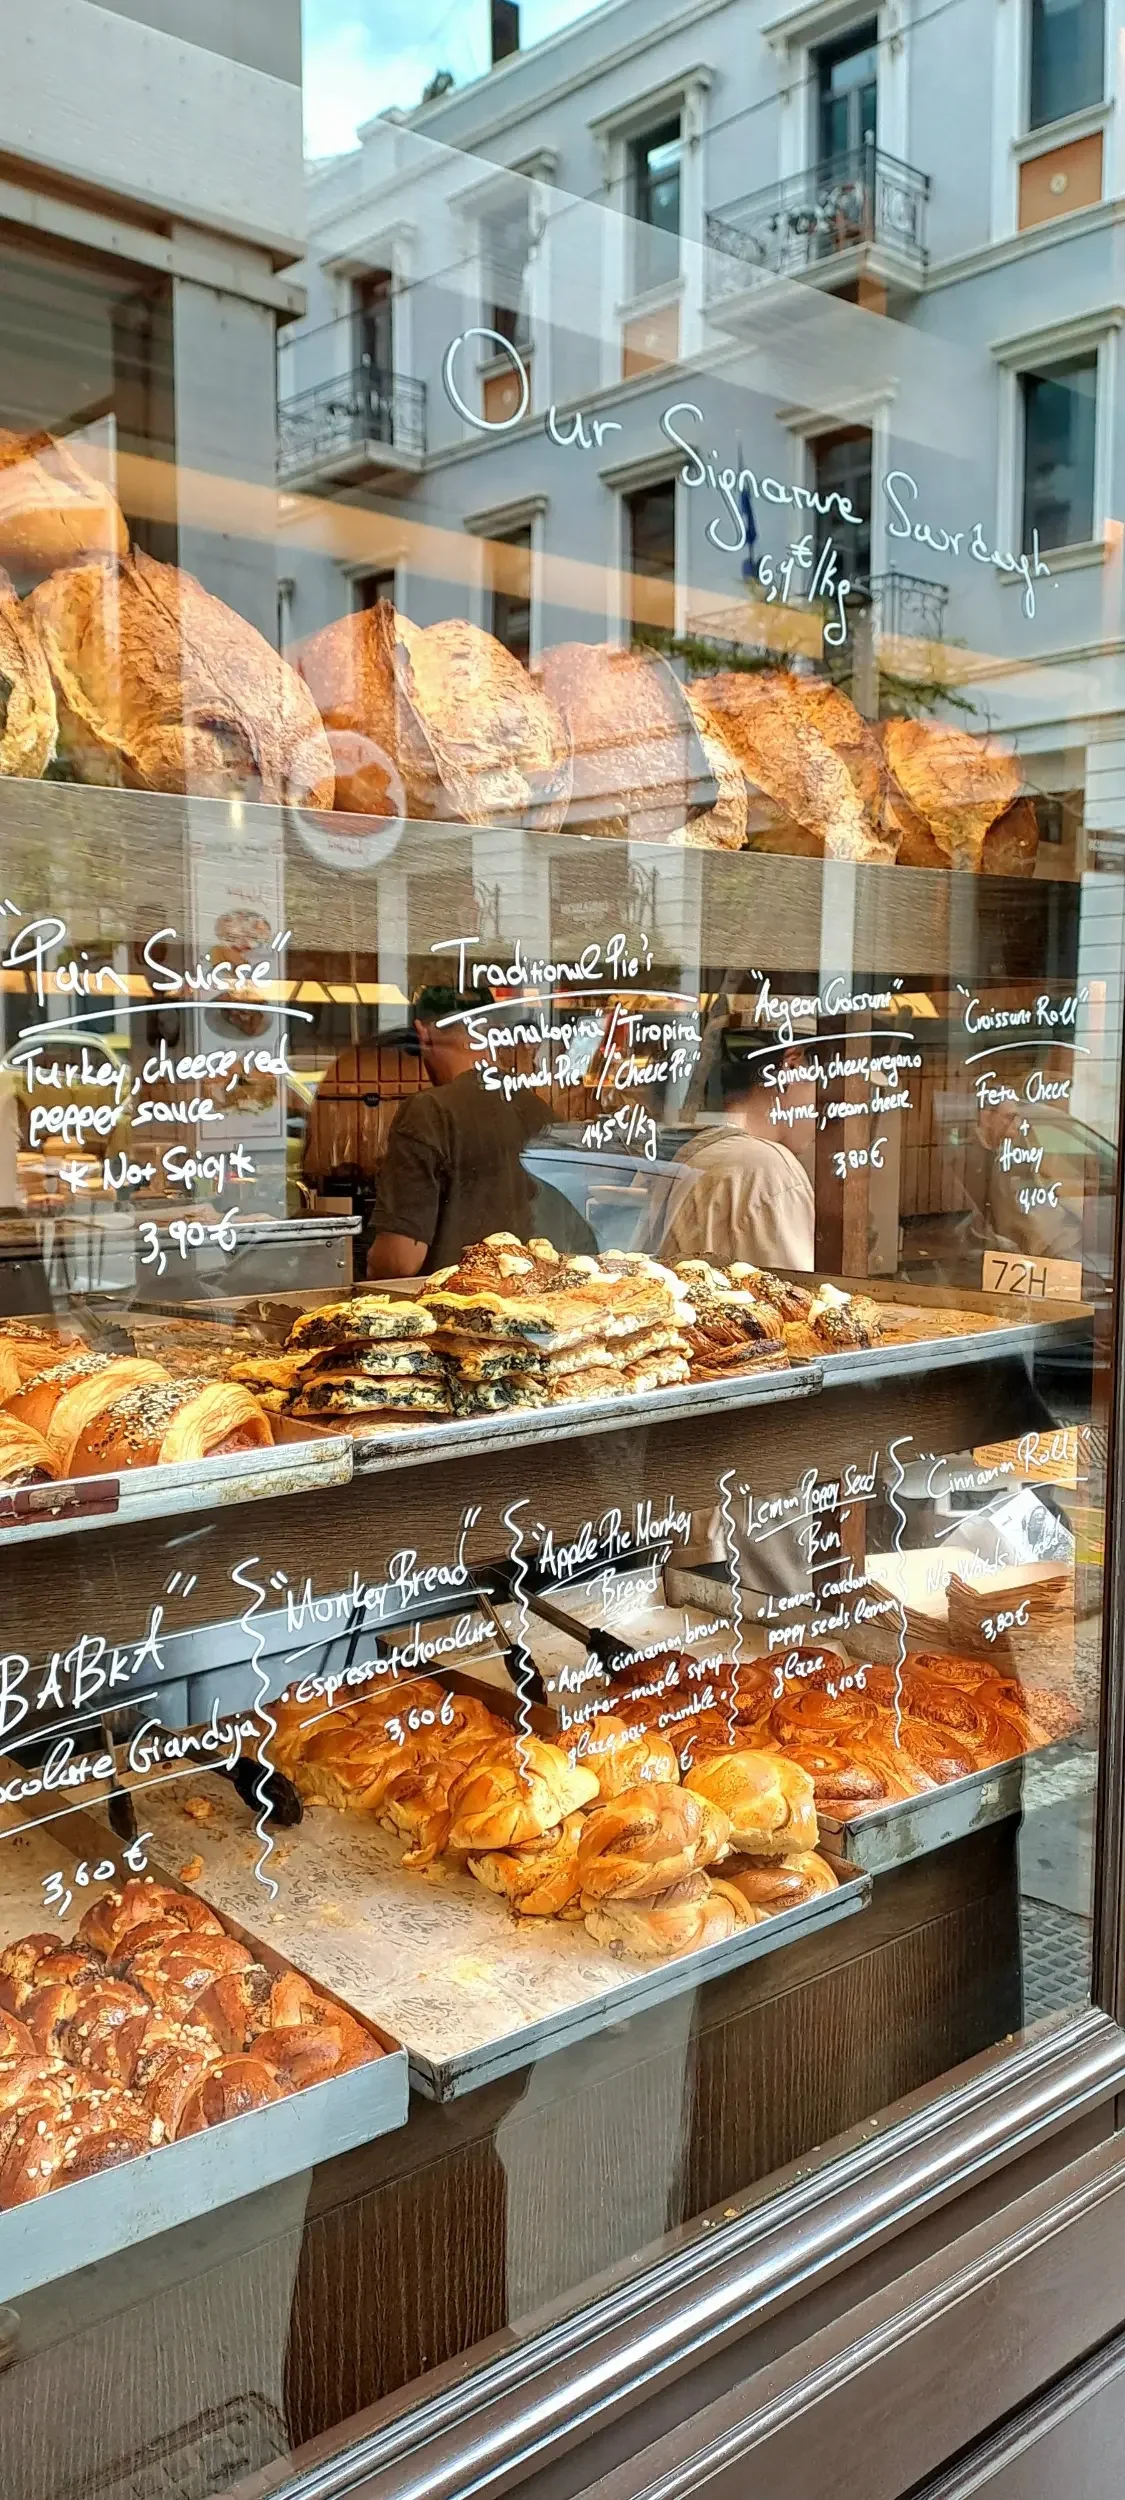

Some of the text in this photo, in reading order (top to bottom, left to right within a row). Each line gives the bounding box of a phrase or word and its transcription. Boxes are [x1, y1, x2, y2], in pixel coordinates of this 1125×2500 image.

[443, 327, 621, 451] Our
[430, 937, 604, 994] Traditional
[243, 1033, 297, 1078] red
[828, 1101, 868, 1118] cream
[975, 1071, 1071, 1109] Feta Cheese
[29, 1101, 123, 1147] pepper
[832, 1137, 888, 1179] 3,80€
[1000, 1137, 1044, 1173] Honey
[138, 1207, 239, 1276] 3,90€
[992, 1259, 1047, 1298] 72H
[801, 1468, 840, 1516] Poppy
[844, 1451, 879, 1496] Seed
[599, 1508, 631, 1558] Pie
[635, 1495, 691, 1545] Monkey
[685, 1614, 730, 1644] brown
[768, 1623, 806, 1652] poppy
[688, 1653, 723, 1681] syrup
[658, 1685, 718, 1728] crumble
